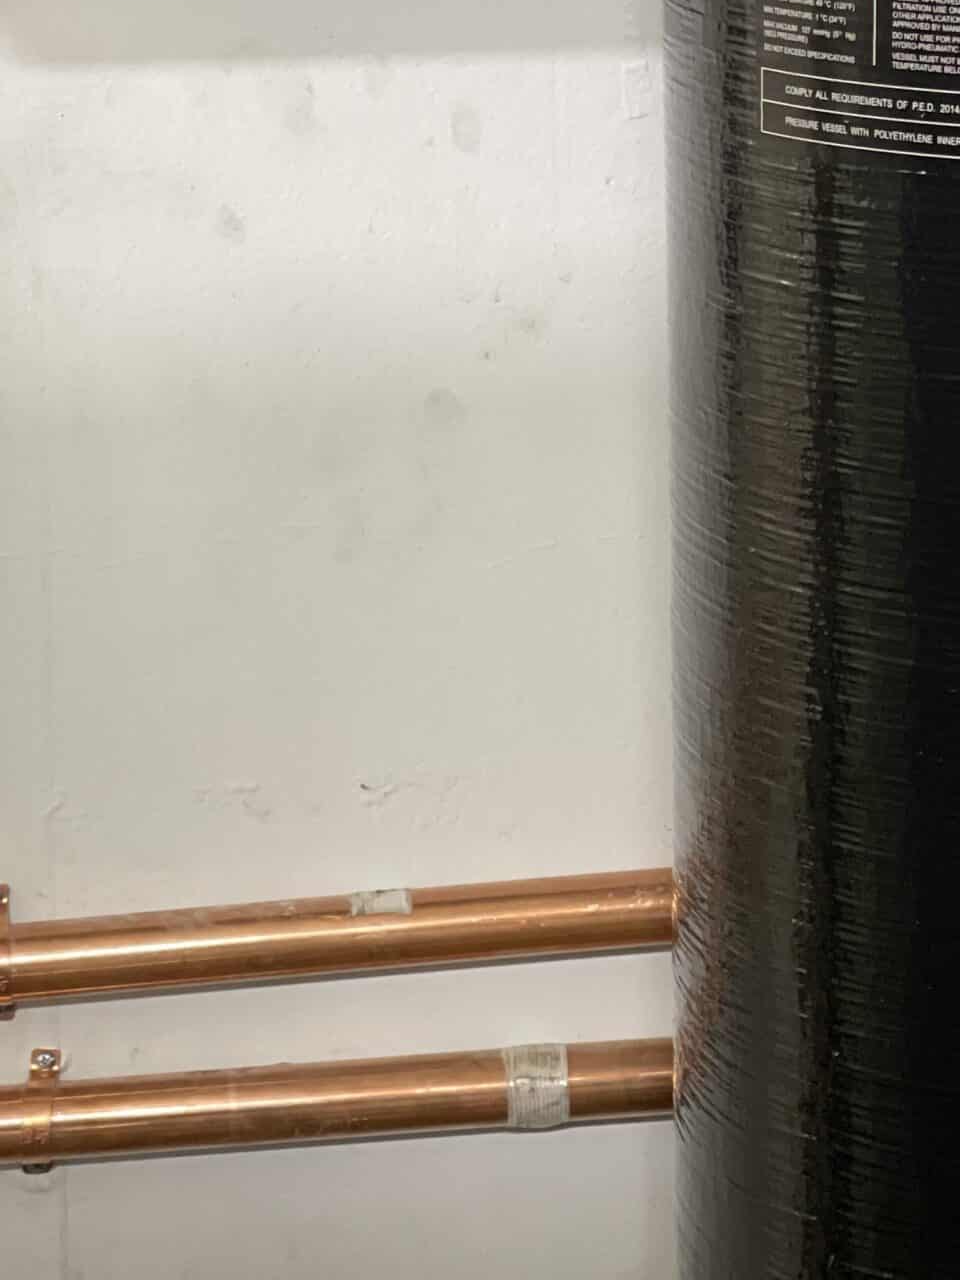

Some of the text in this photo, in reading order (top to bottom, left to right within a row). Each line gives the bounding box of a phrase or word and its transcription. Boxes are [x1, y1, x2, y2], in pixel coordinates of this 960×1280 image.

[892, 2, 931, 12] FILTRATION
[892, 11, 916, 19] OTHER
[892, 20, 930, 30] APPROVED
[892, 31, 903, 39] DO
[904, 33, 918, 41] NOT
[920, 34, 934, 42] USE
[936, 35, 951, 43] FOR
[892, 52, 917, 61] VESSEL
[919, 54, 939, 63] MUST
[940, 56, 955, 65] NOT
[892, 61, 942, 73] TEMPERATURE
[785, 85, 813, 98] COMPLY
[815, 89, 829, 100] ALL
[831, 92, 893, 109] REQUIREMENTS
[896, 100, 908, 110] OF
[911, 101, 936, 113] P.E.D.
[785, 116, 819, 131] PRESSURE
[821, 122, 848, 135] VESSEL
[850, 126, 870, 137] WITH
[873, 128, 934, 144] POLYETHYLENE
